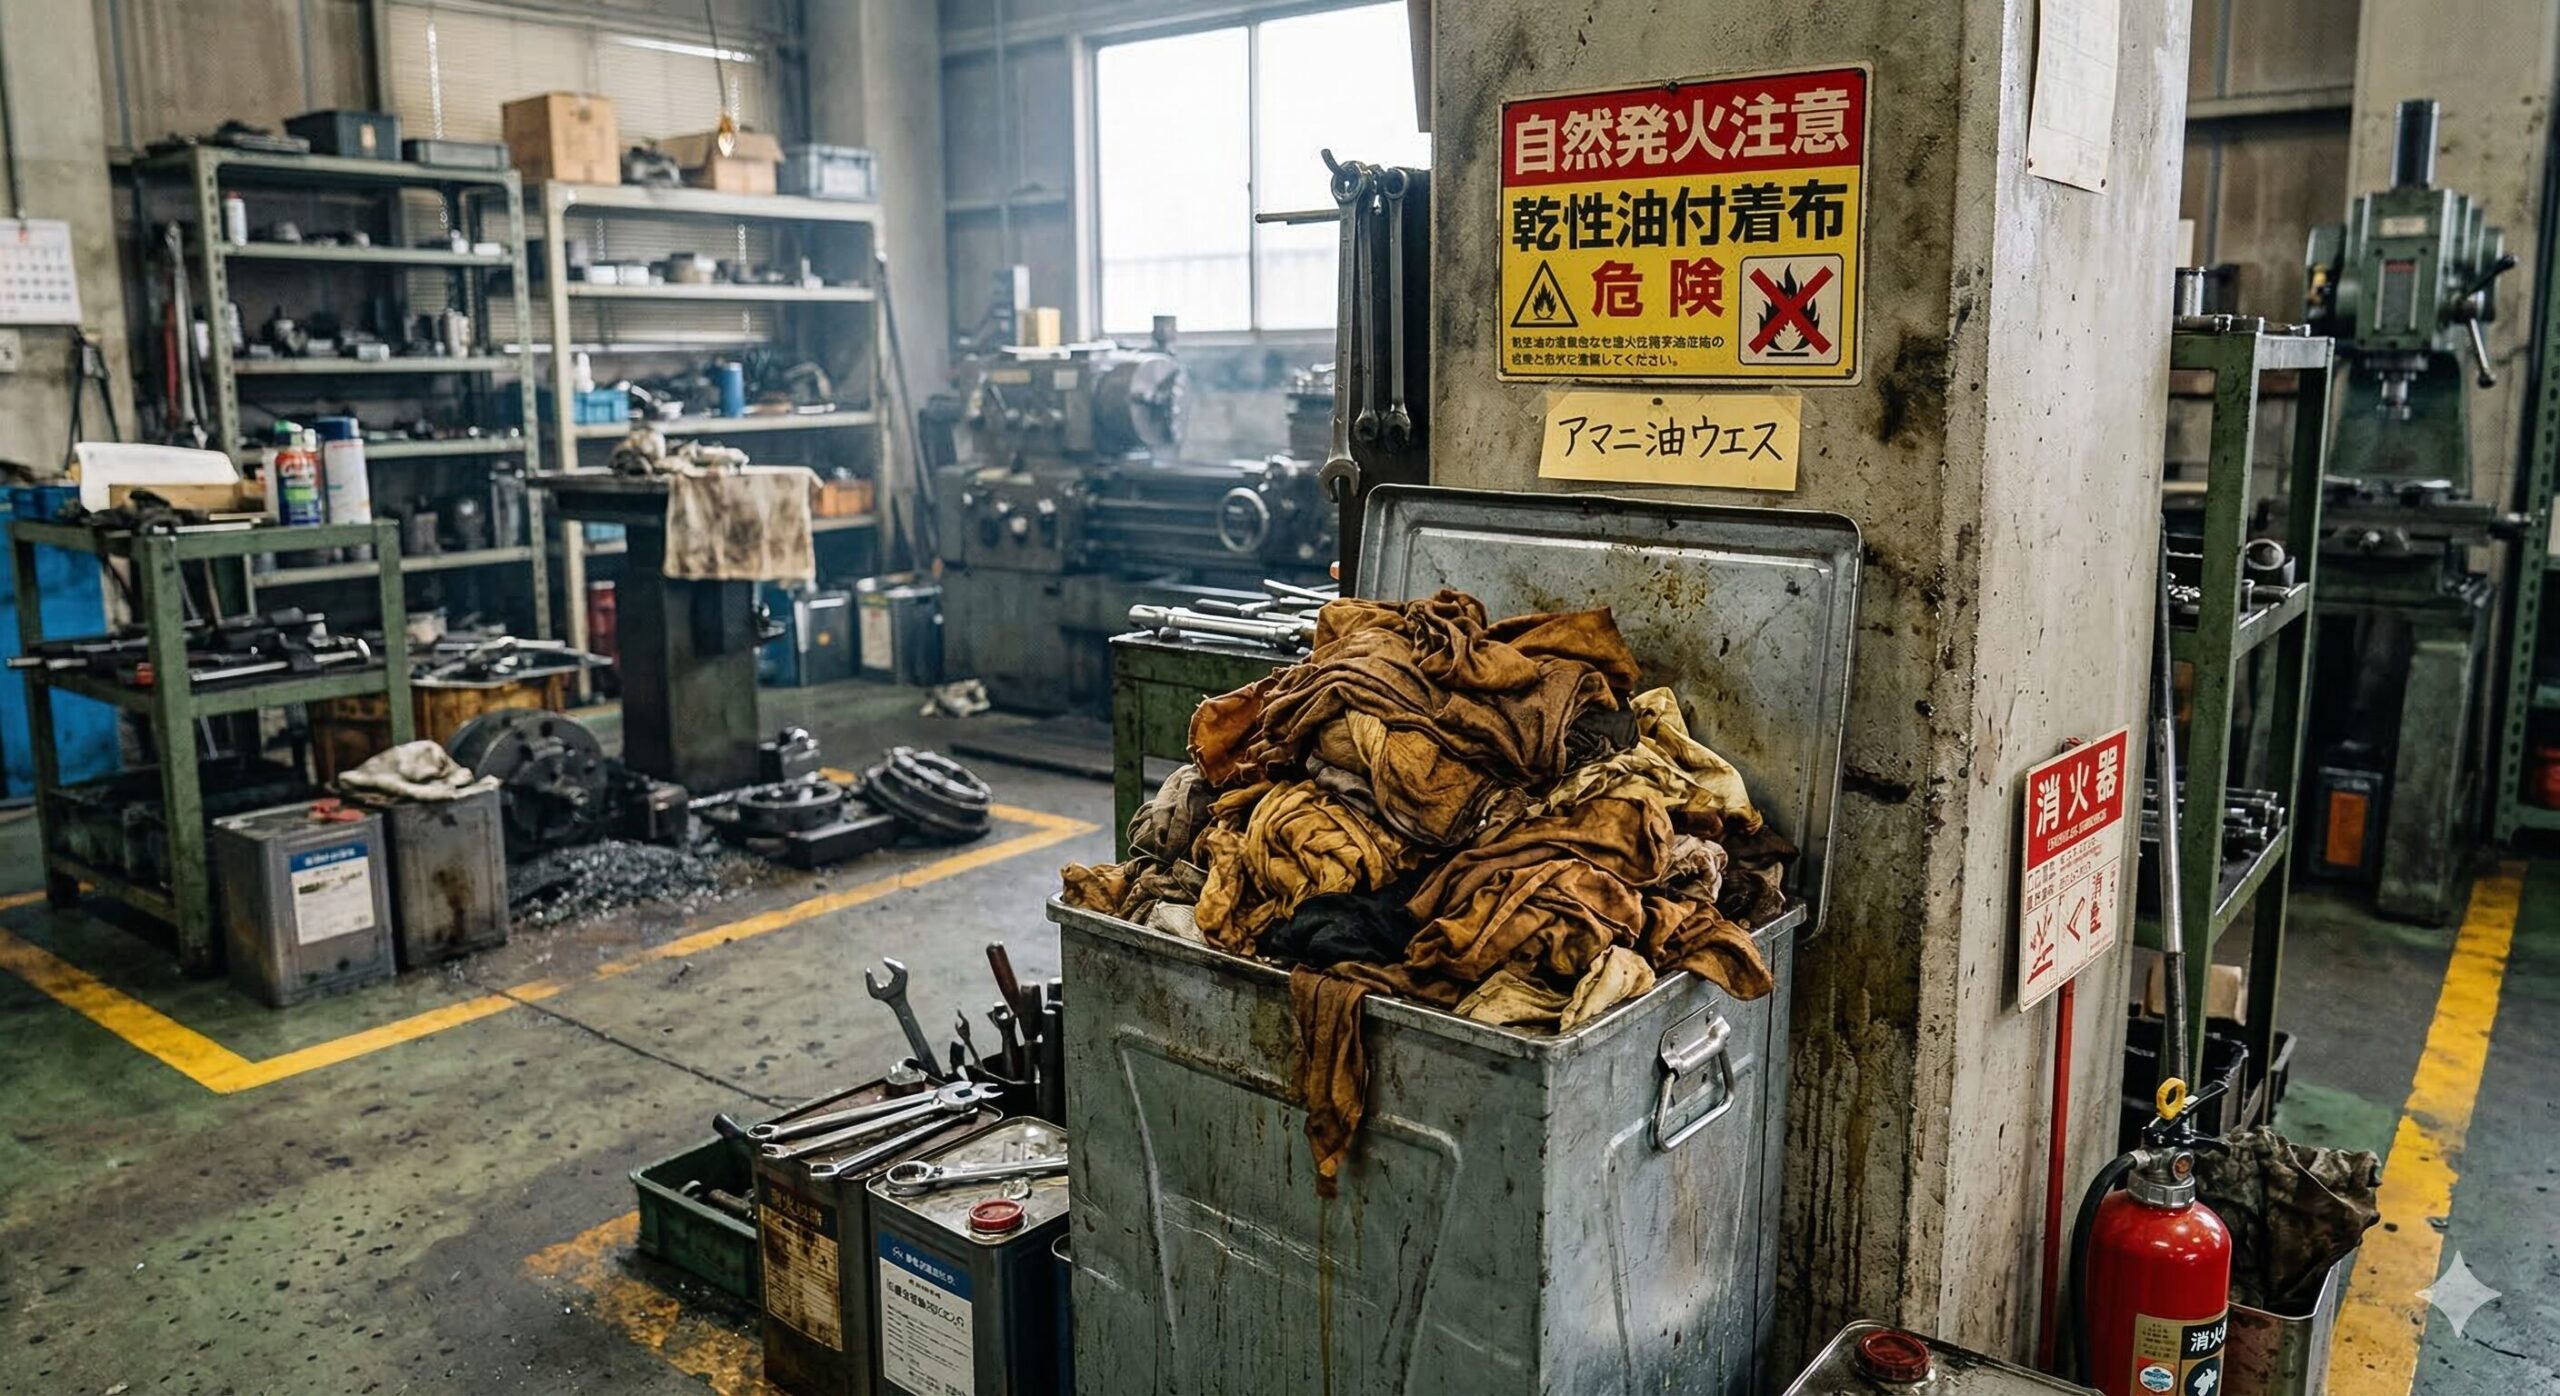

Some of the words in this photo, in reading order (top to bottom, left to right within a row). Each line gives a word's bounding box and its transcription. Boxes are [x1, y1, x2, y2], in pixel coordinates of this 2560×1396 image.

[1515, 88, 1850, 175] 自然発火注意
[1512, 179, 1848, 252] 乾性油付着布
[2036, 745, 2118, 838] 消火器
